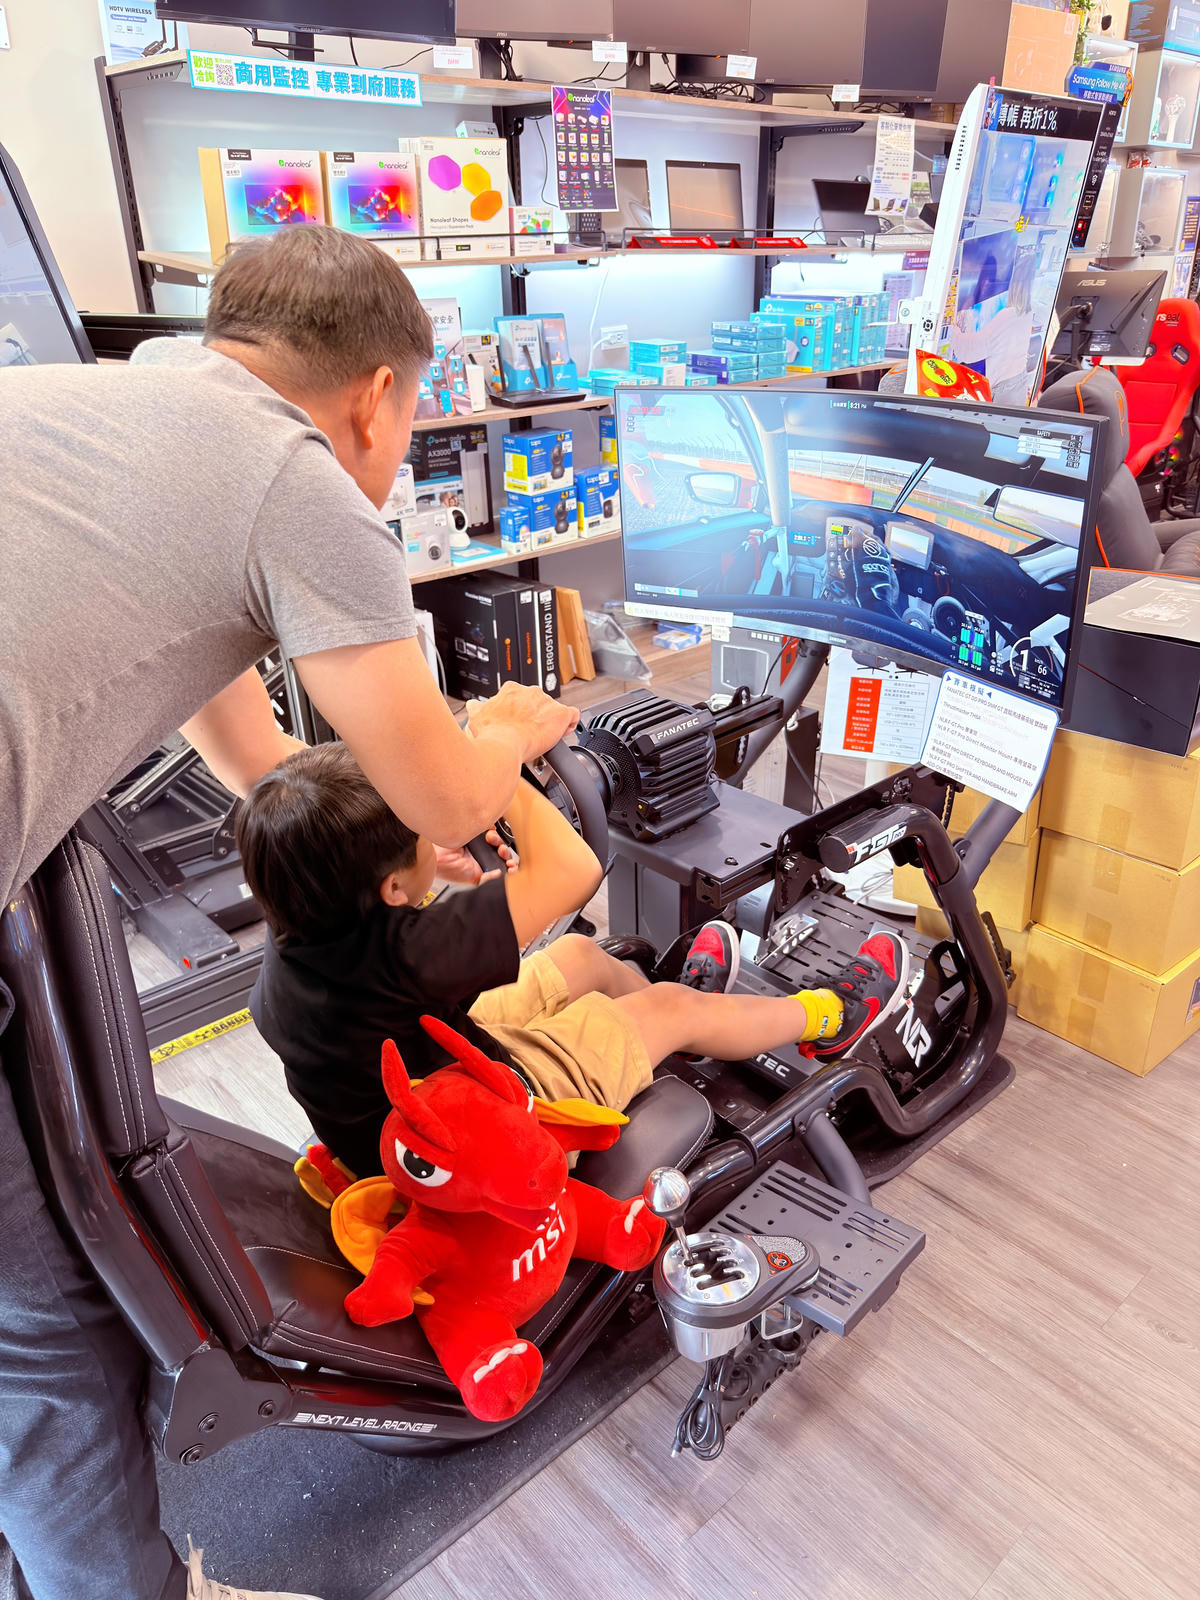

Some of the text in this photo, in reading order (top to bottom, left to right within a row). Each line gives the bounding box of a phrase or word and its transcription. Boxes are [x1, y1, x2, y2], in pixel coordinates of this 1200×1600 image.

[125, 7, 152, 15] WIRELESS
[193, 55, 213, 70] 歡迎
[234, 61, 416, 99] 商用監控 專業到府服務
[1072, 73, 1096, 89] Samsung
[1096, 78, 1111, 89] Follow
[1111, 80, 1119, 90] Me
[573, 94, 597, 103] nanoleaf
[1020, 106, 1058, 132] 再折1%
[285, 160, 313, 169] nanoleaf
[384, 162, 409, 170] nanoleaf
[1077, 279, 1108, 287] ASUS
[1036, 430, 1051, 438] SAFETY
[544, 613, 555, 672] ERGOSTAND
[1019, 649, 1029, 672] 1
[1037, 664, 1048, 676] 66
[656, 717, 700, 740] FANATEC
[511, 1210, 566, 1282] msi
[307, 1413, 424, 1432] NEXT LEVEL RACING
